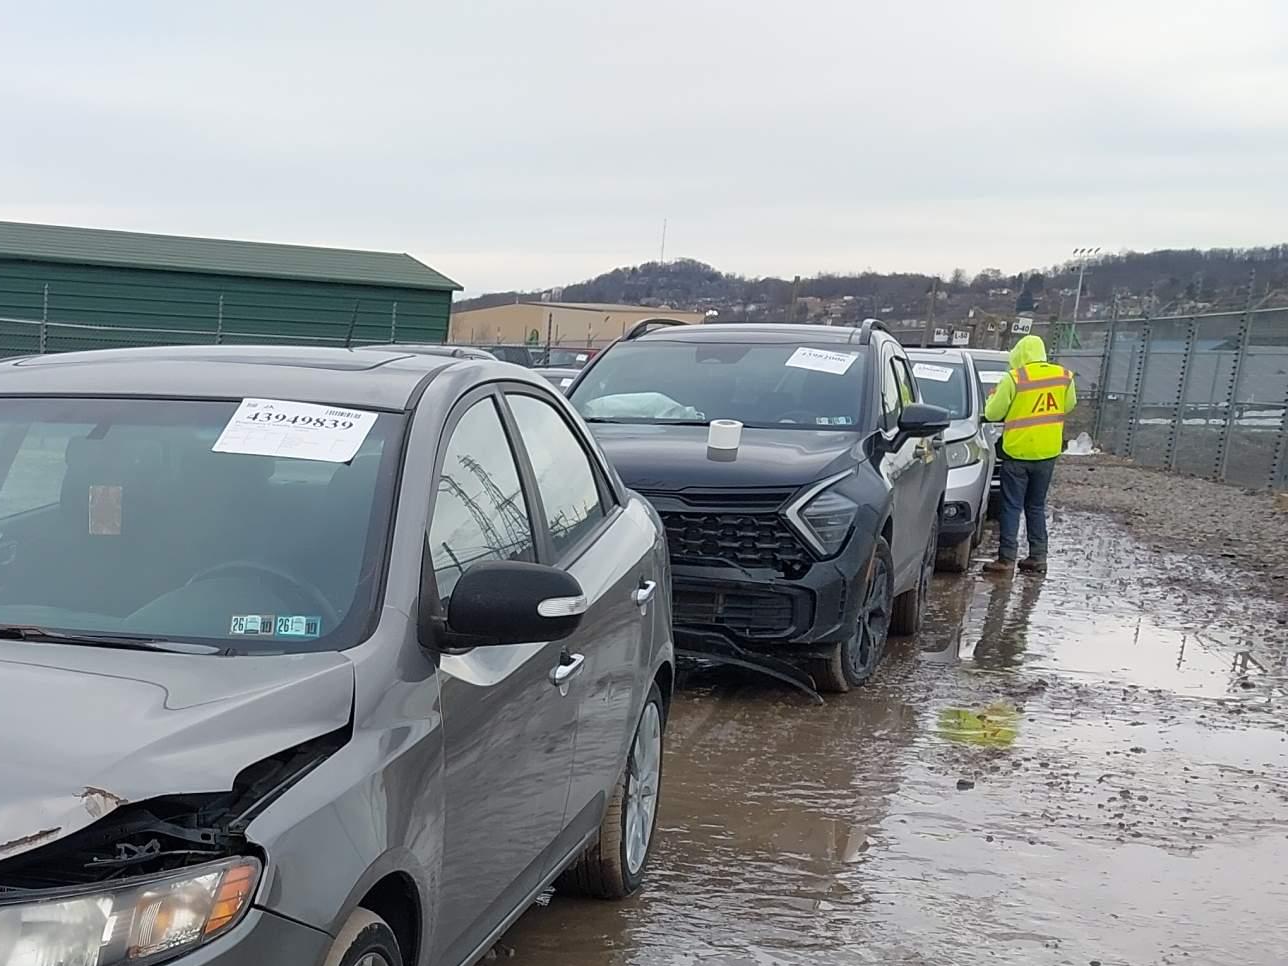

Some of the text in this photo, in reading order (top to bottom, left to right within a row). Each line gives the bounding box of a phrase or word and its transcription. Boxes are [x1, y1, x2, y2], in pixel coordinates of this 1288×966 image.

[246, 411, 354, 431] 43949839
[233, 617, 244, 632] 26
[278, 618, 290, 633] 26
